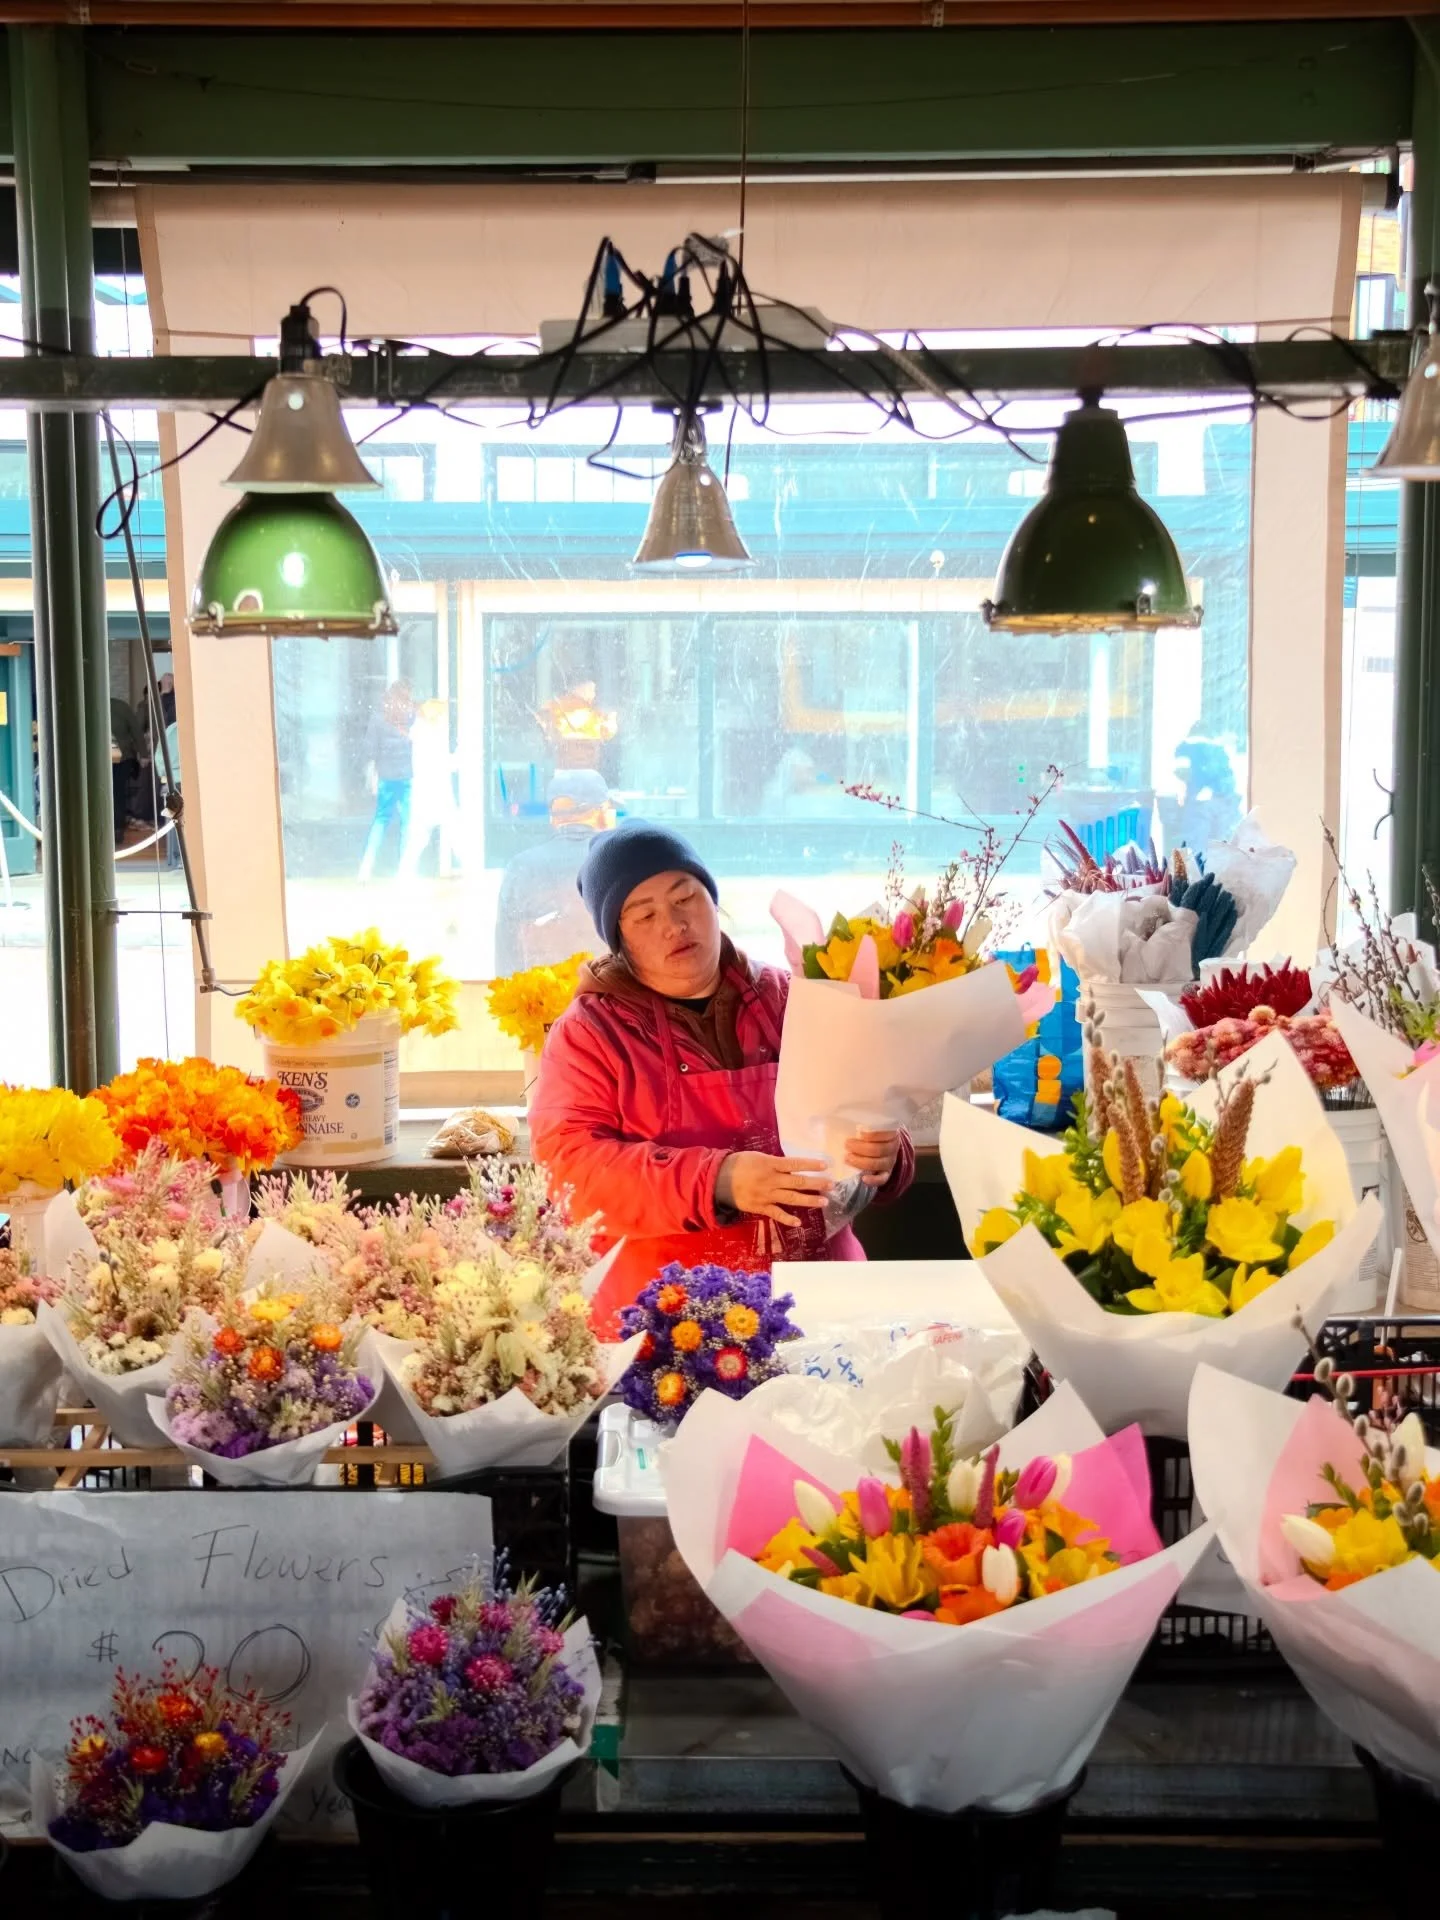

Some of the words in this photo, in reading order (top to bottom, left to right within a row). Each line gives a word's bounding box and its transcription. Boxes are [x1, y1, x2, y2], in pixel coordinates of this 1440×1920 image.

[277, 1071, 328, 1090] KEN'S
[302, 1114, 326, 1122] HEAVY
[297, 1122, 345, 1134] NNAISE
[0, 1547, 132, 1624] Dried
[192, 1524, 389, 1589] Flowers
